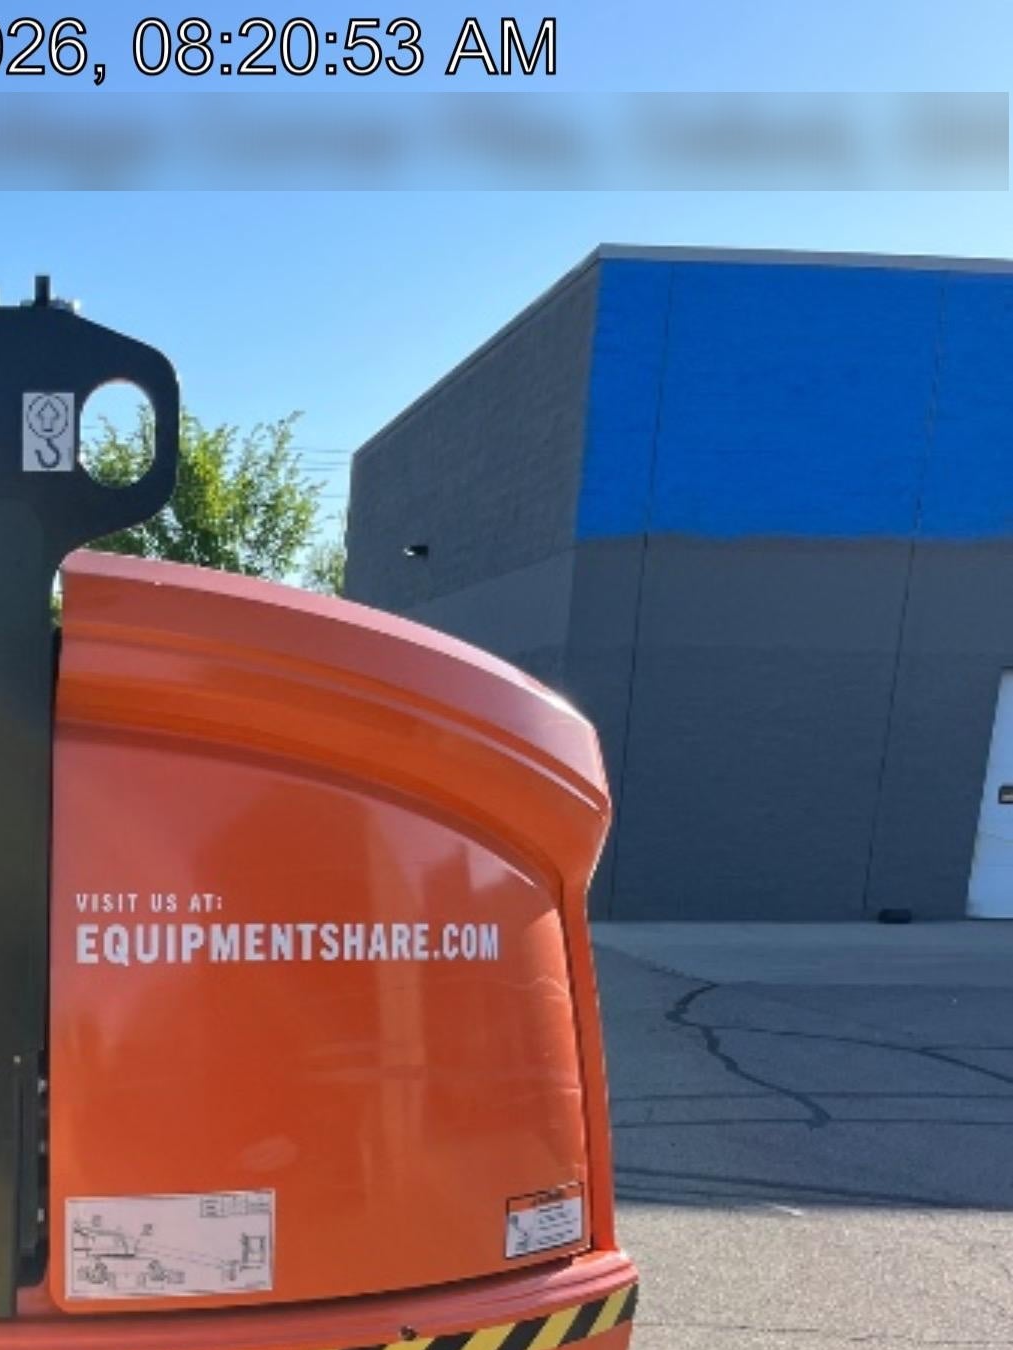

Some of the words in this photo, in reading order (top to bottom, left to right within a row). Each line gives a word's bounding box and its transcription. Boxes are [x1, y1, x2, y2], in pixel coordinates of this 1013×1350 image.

[75, 893, 138, 913] VISIT
[151, 893, 178, 913] US
[190, 893, 223, 913] AT:
[75, 923, 500, 966] EQUIPMENTSHARE.COM
